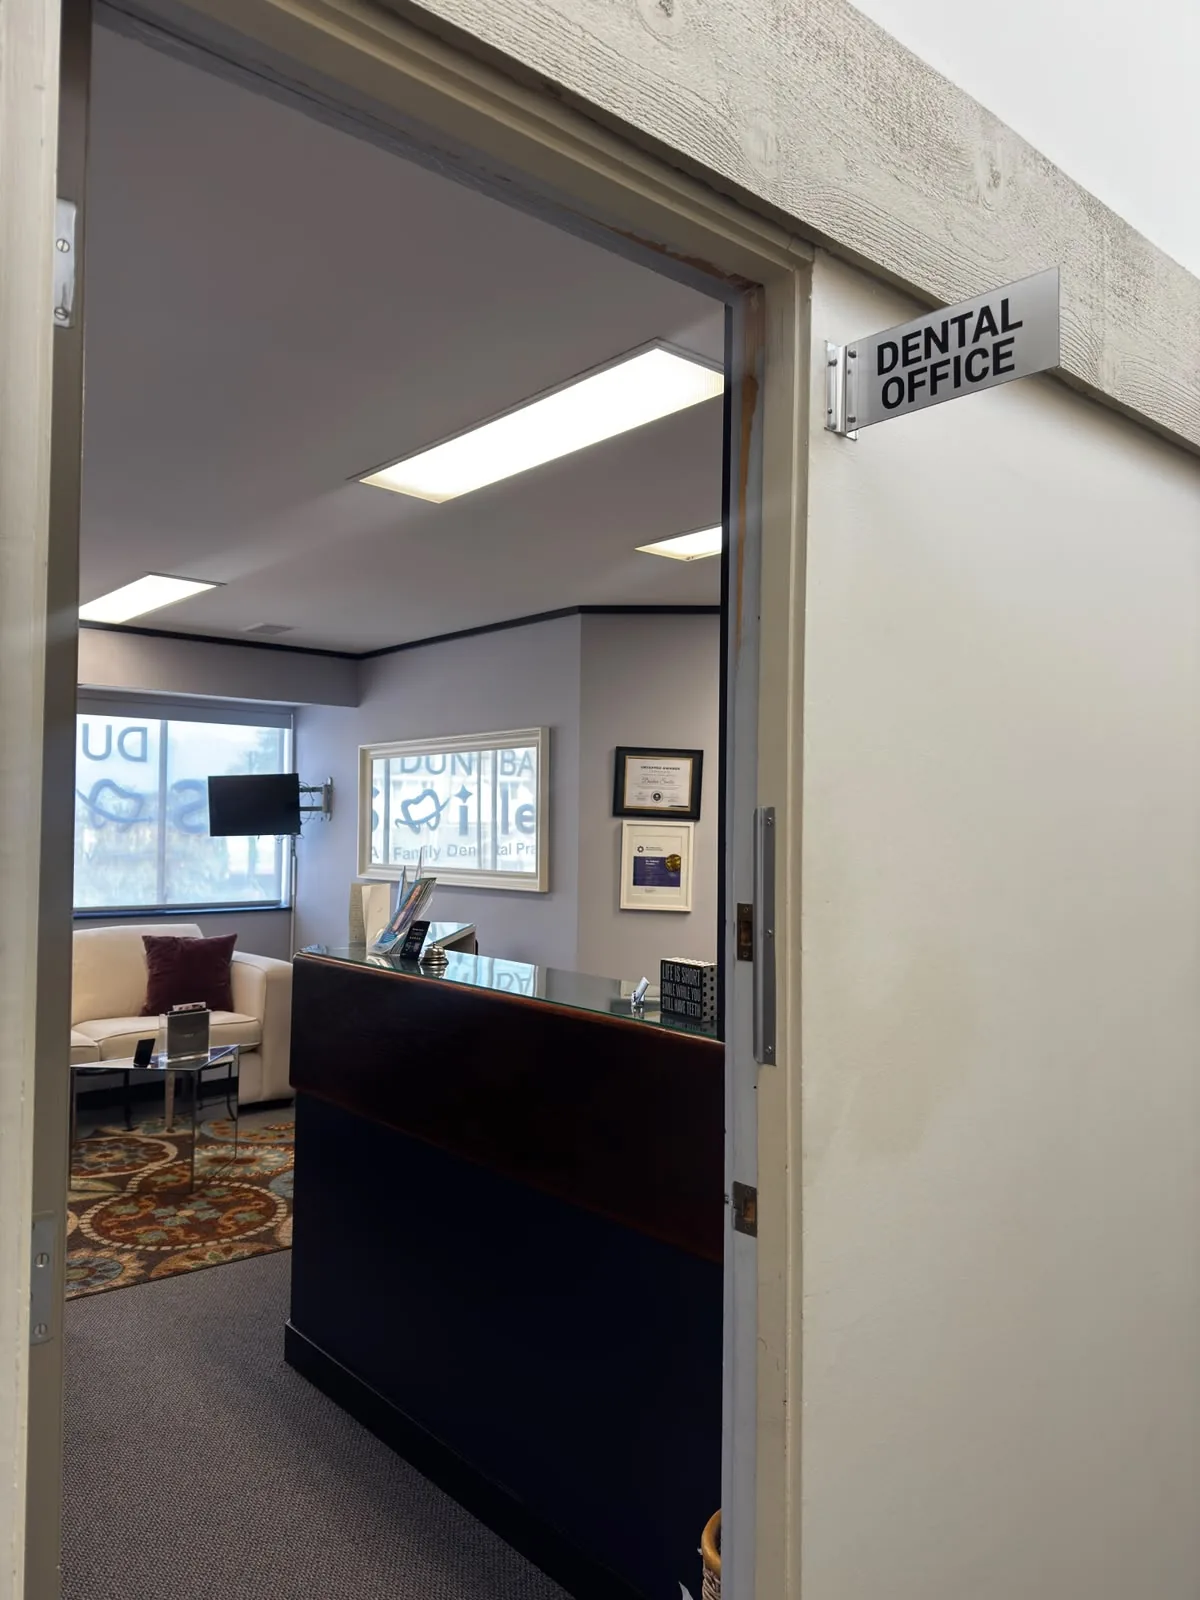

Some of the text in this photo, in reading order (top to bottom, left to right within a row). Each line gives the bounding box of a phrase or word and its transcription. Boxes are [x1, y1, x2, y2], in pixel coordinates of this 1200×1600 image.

[877, 298, 1023, 376] DENTAL
[881, 337, 1015, 409] OFFICE
[662, 962, 700, 986] LIFE IS SHORT
[676, 984, 690, 1000] WHILE
[691, 987, 701, 1002] YOU
[686, 1003, 701, 1018] TEETH
